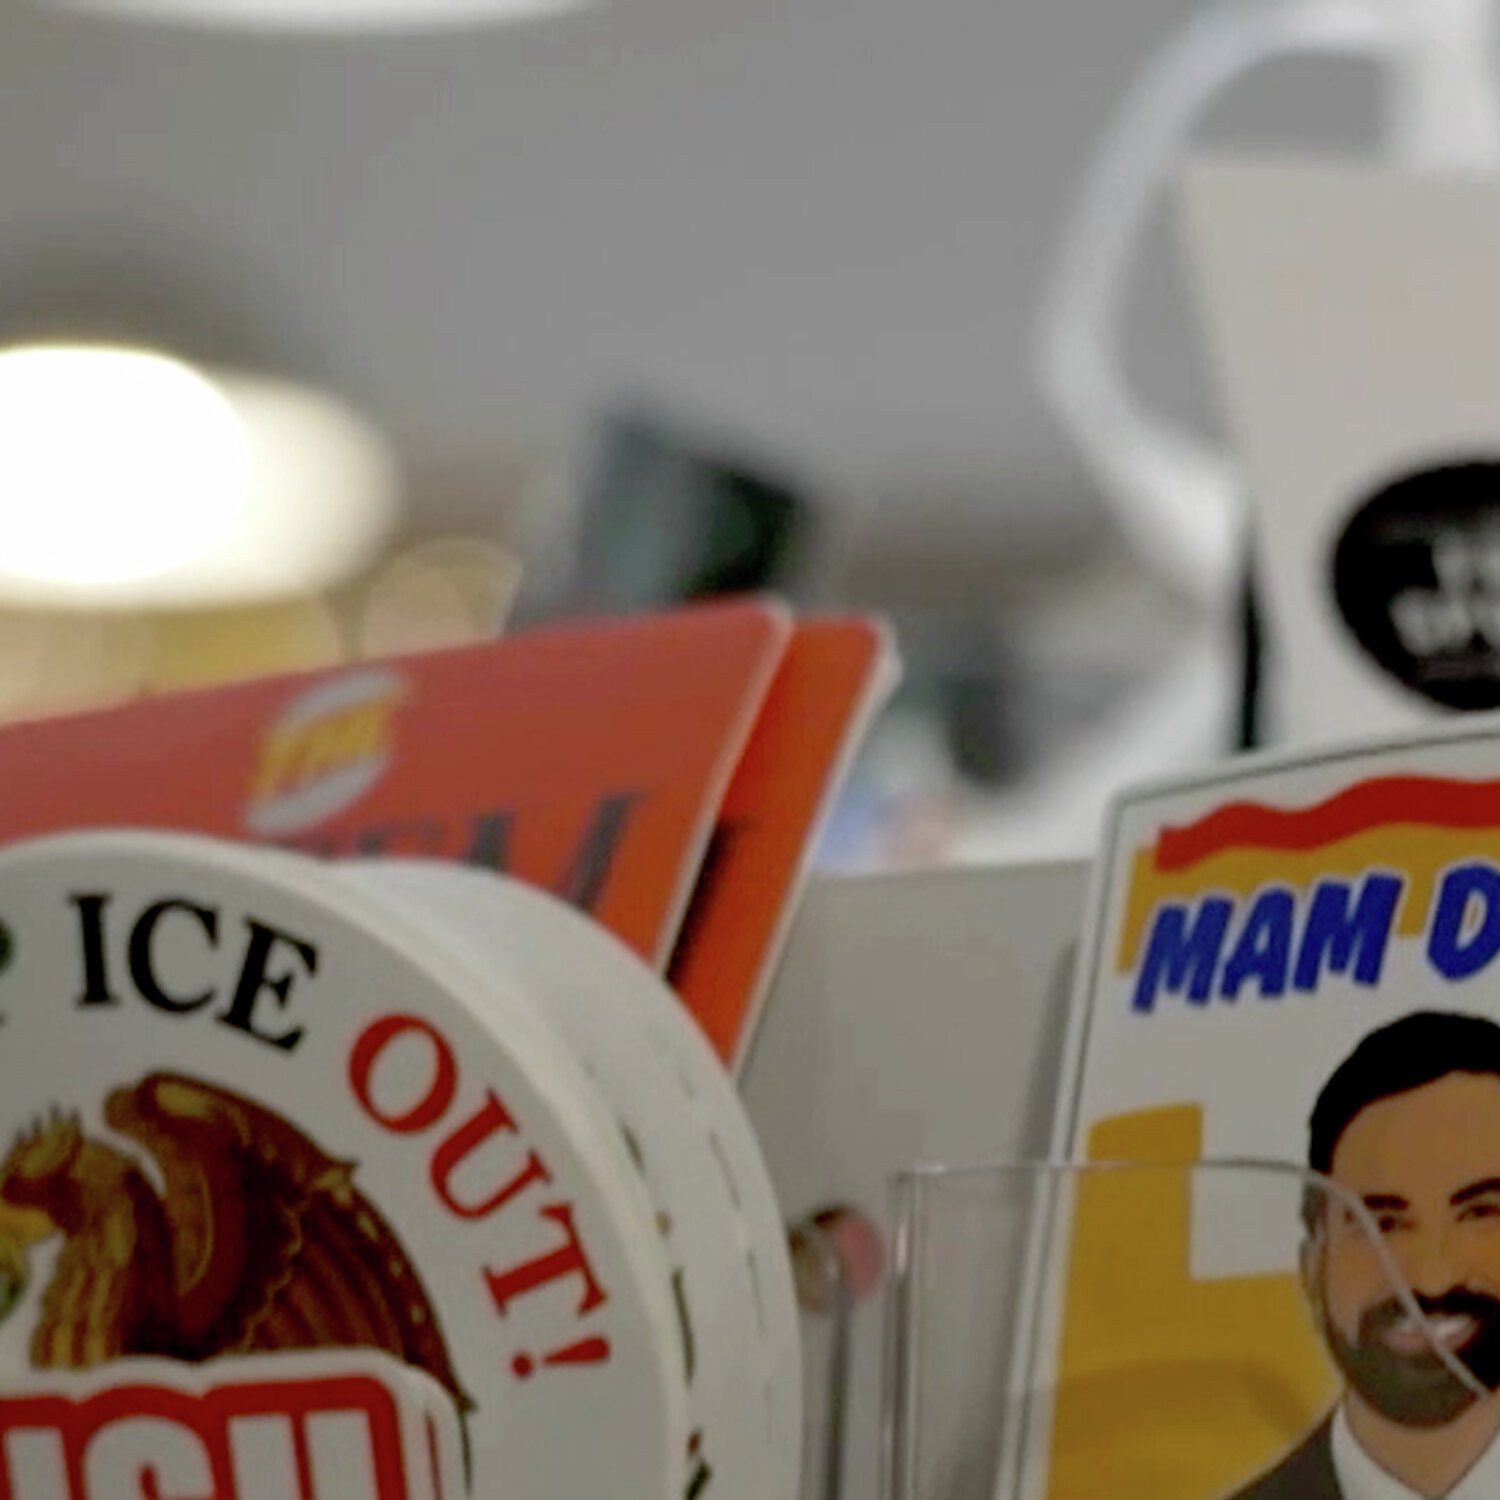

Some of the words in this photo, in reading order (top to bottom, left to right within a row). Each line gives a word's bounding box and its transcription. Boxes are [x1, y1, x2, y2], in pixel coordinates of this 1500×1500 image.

[1130, 874, 1402, 1012] MAM
[68, 893, 319, 1054] ICE
[348, 1012, 611, 1381] OUT!
